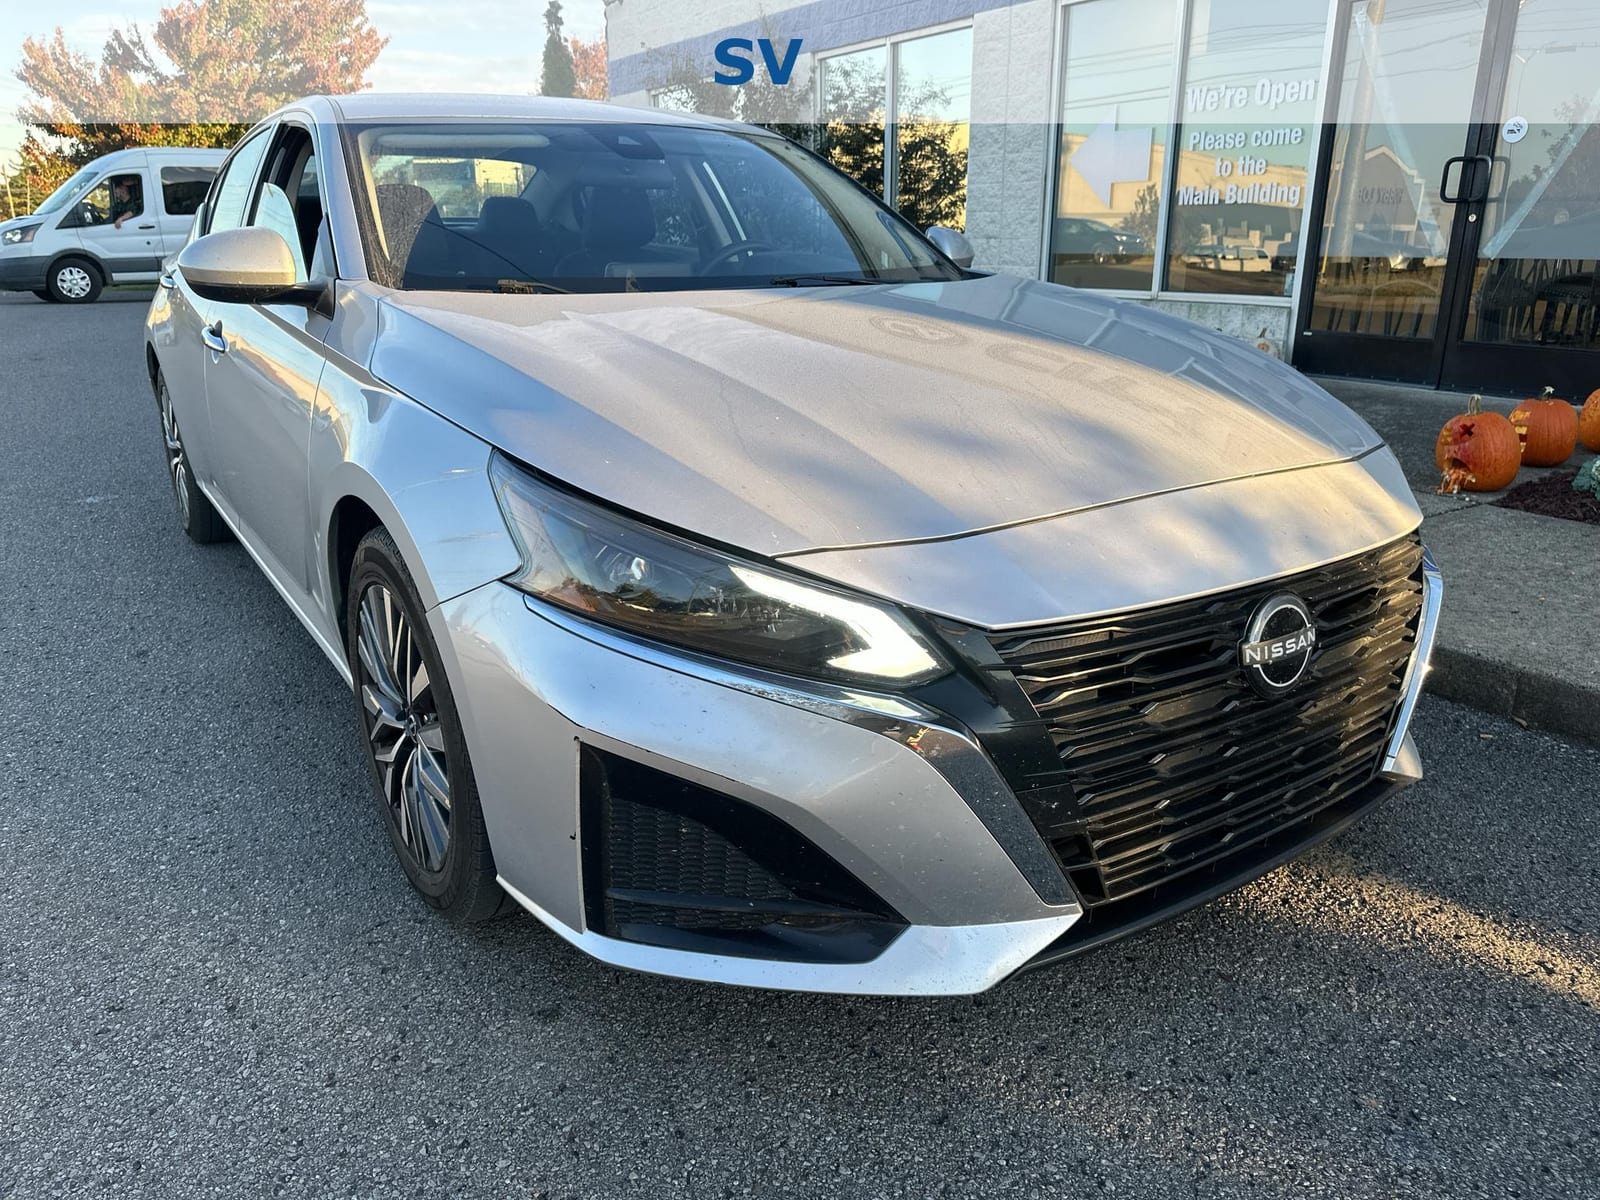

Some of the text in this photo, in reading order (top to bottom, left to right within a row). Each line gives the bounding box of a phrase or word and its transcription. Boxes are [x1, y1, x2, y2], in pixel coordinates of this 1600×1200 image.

[1187, 78, 1316, 113] We're Open
[1189, 127, 1303, 152] Please come
[1215, 155, 1267, 177] to the
[1178, 182, 1301, 208] Main Building
[1245, 628, 1316, 663] NISSAN
